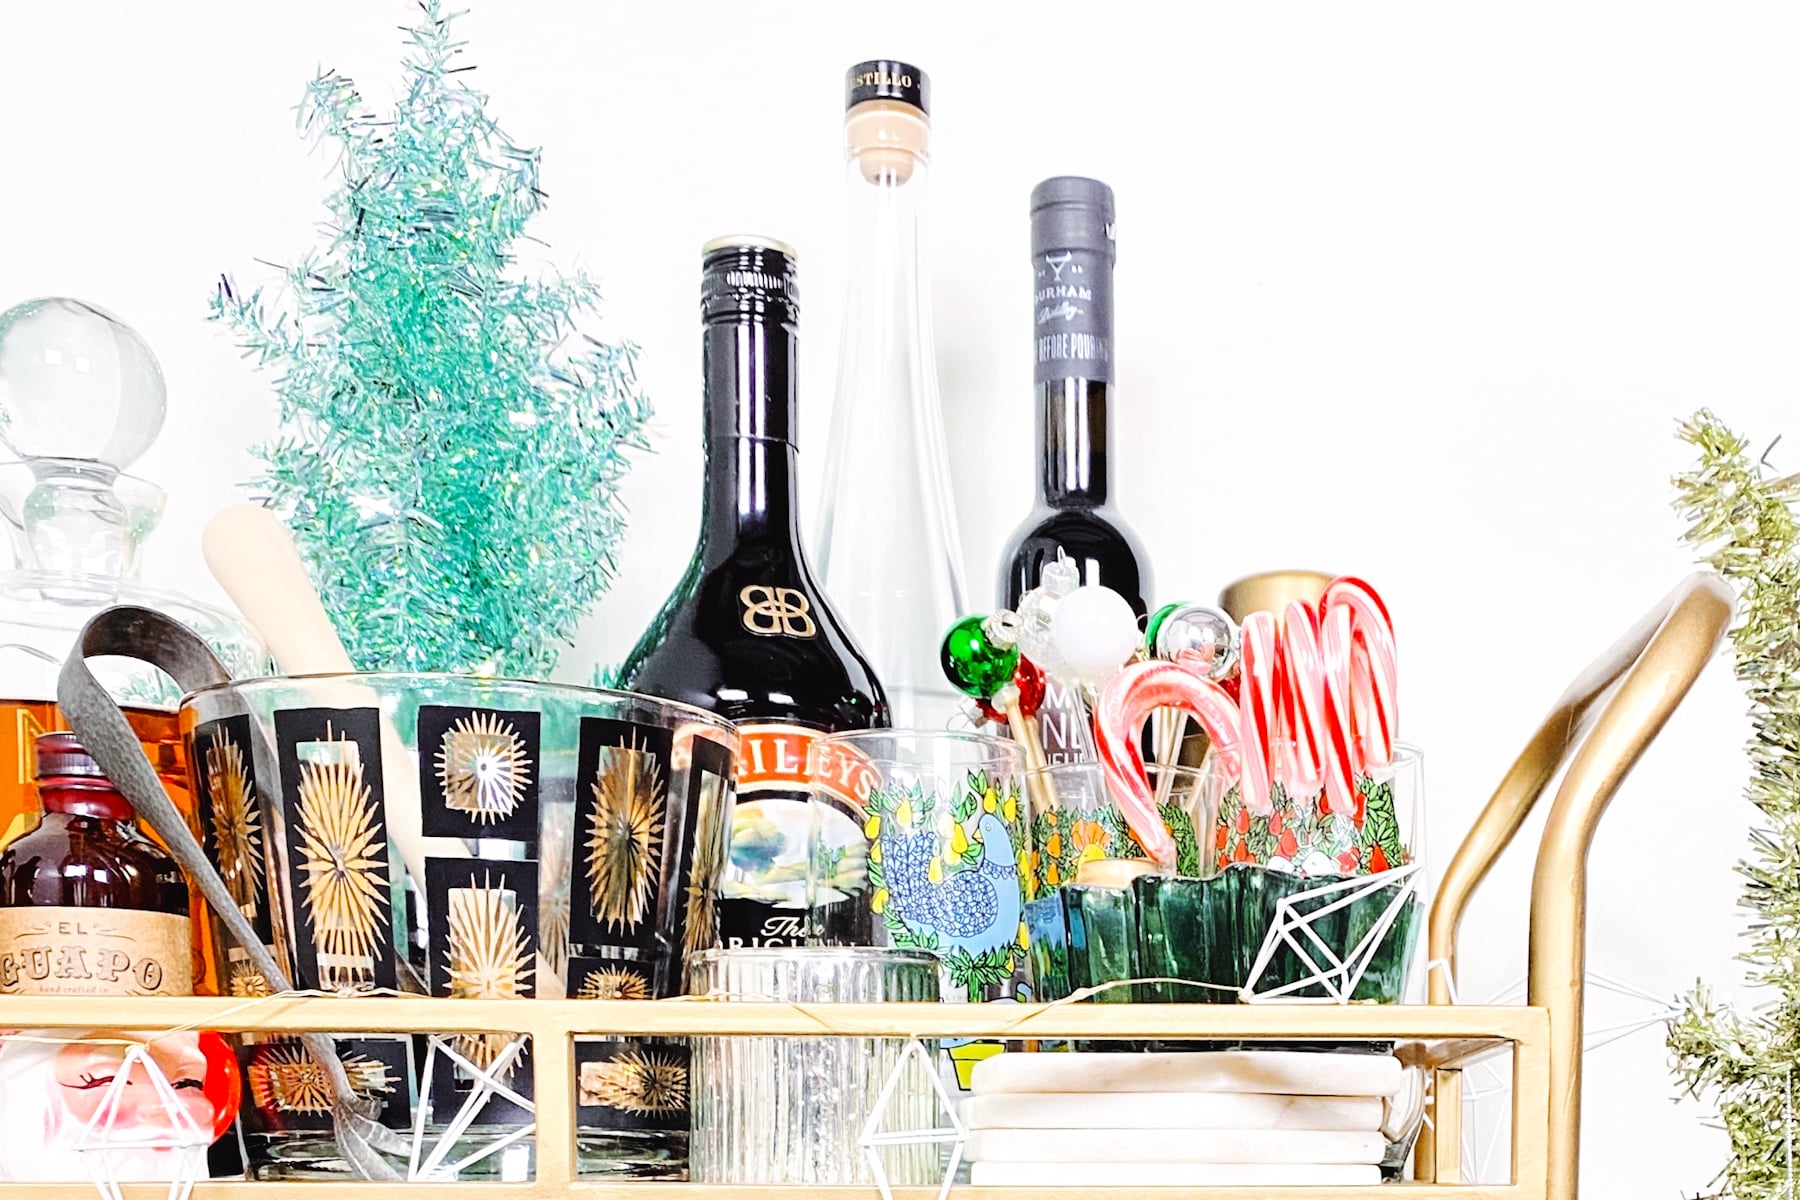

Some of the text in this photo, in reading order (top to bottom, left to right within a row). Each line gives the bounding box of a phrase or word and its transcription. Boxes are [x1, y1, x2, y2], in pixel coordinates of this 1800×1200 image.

[1039, 333, 1068, 362] BEFORE
[58, 921, 88, 935] EL
[760, 915, 825, 937] The
[0, 945, 163, 991] GUAPO
